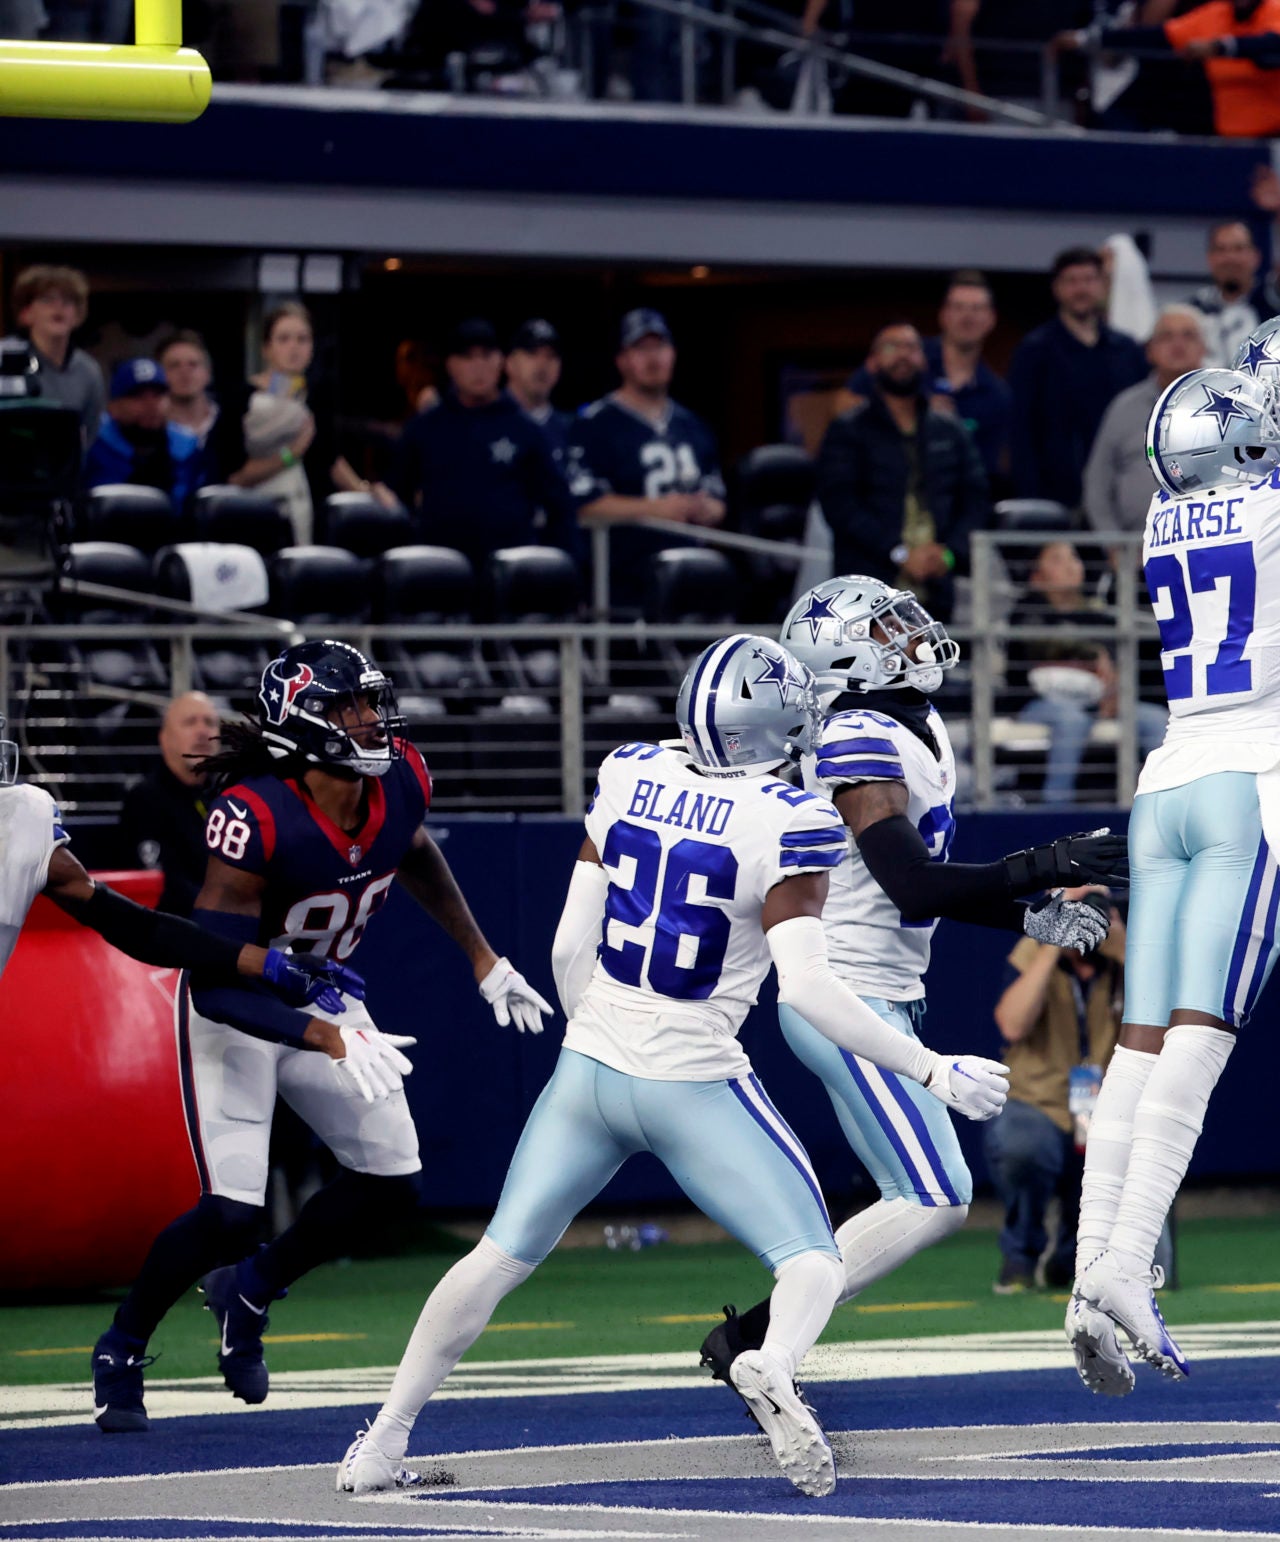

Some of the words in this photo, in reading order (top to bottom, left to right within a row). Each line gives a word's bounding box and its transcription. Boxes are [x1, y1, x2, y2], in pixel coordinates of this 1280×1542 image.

[640, 442, 701, 500] 21
[1150, 498, 1244, 547] KEARSE
[1144, 540, 1257, 701] 27
[206, 807, 251, 860] 88
[626, 779, 735, 836] BLAND
[337, 869, 372, 884] TEXANS
[600, 818, 740, 1000] 26
